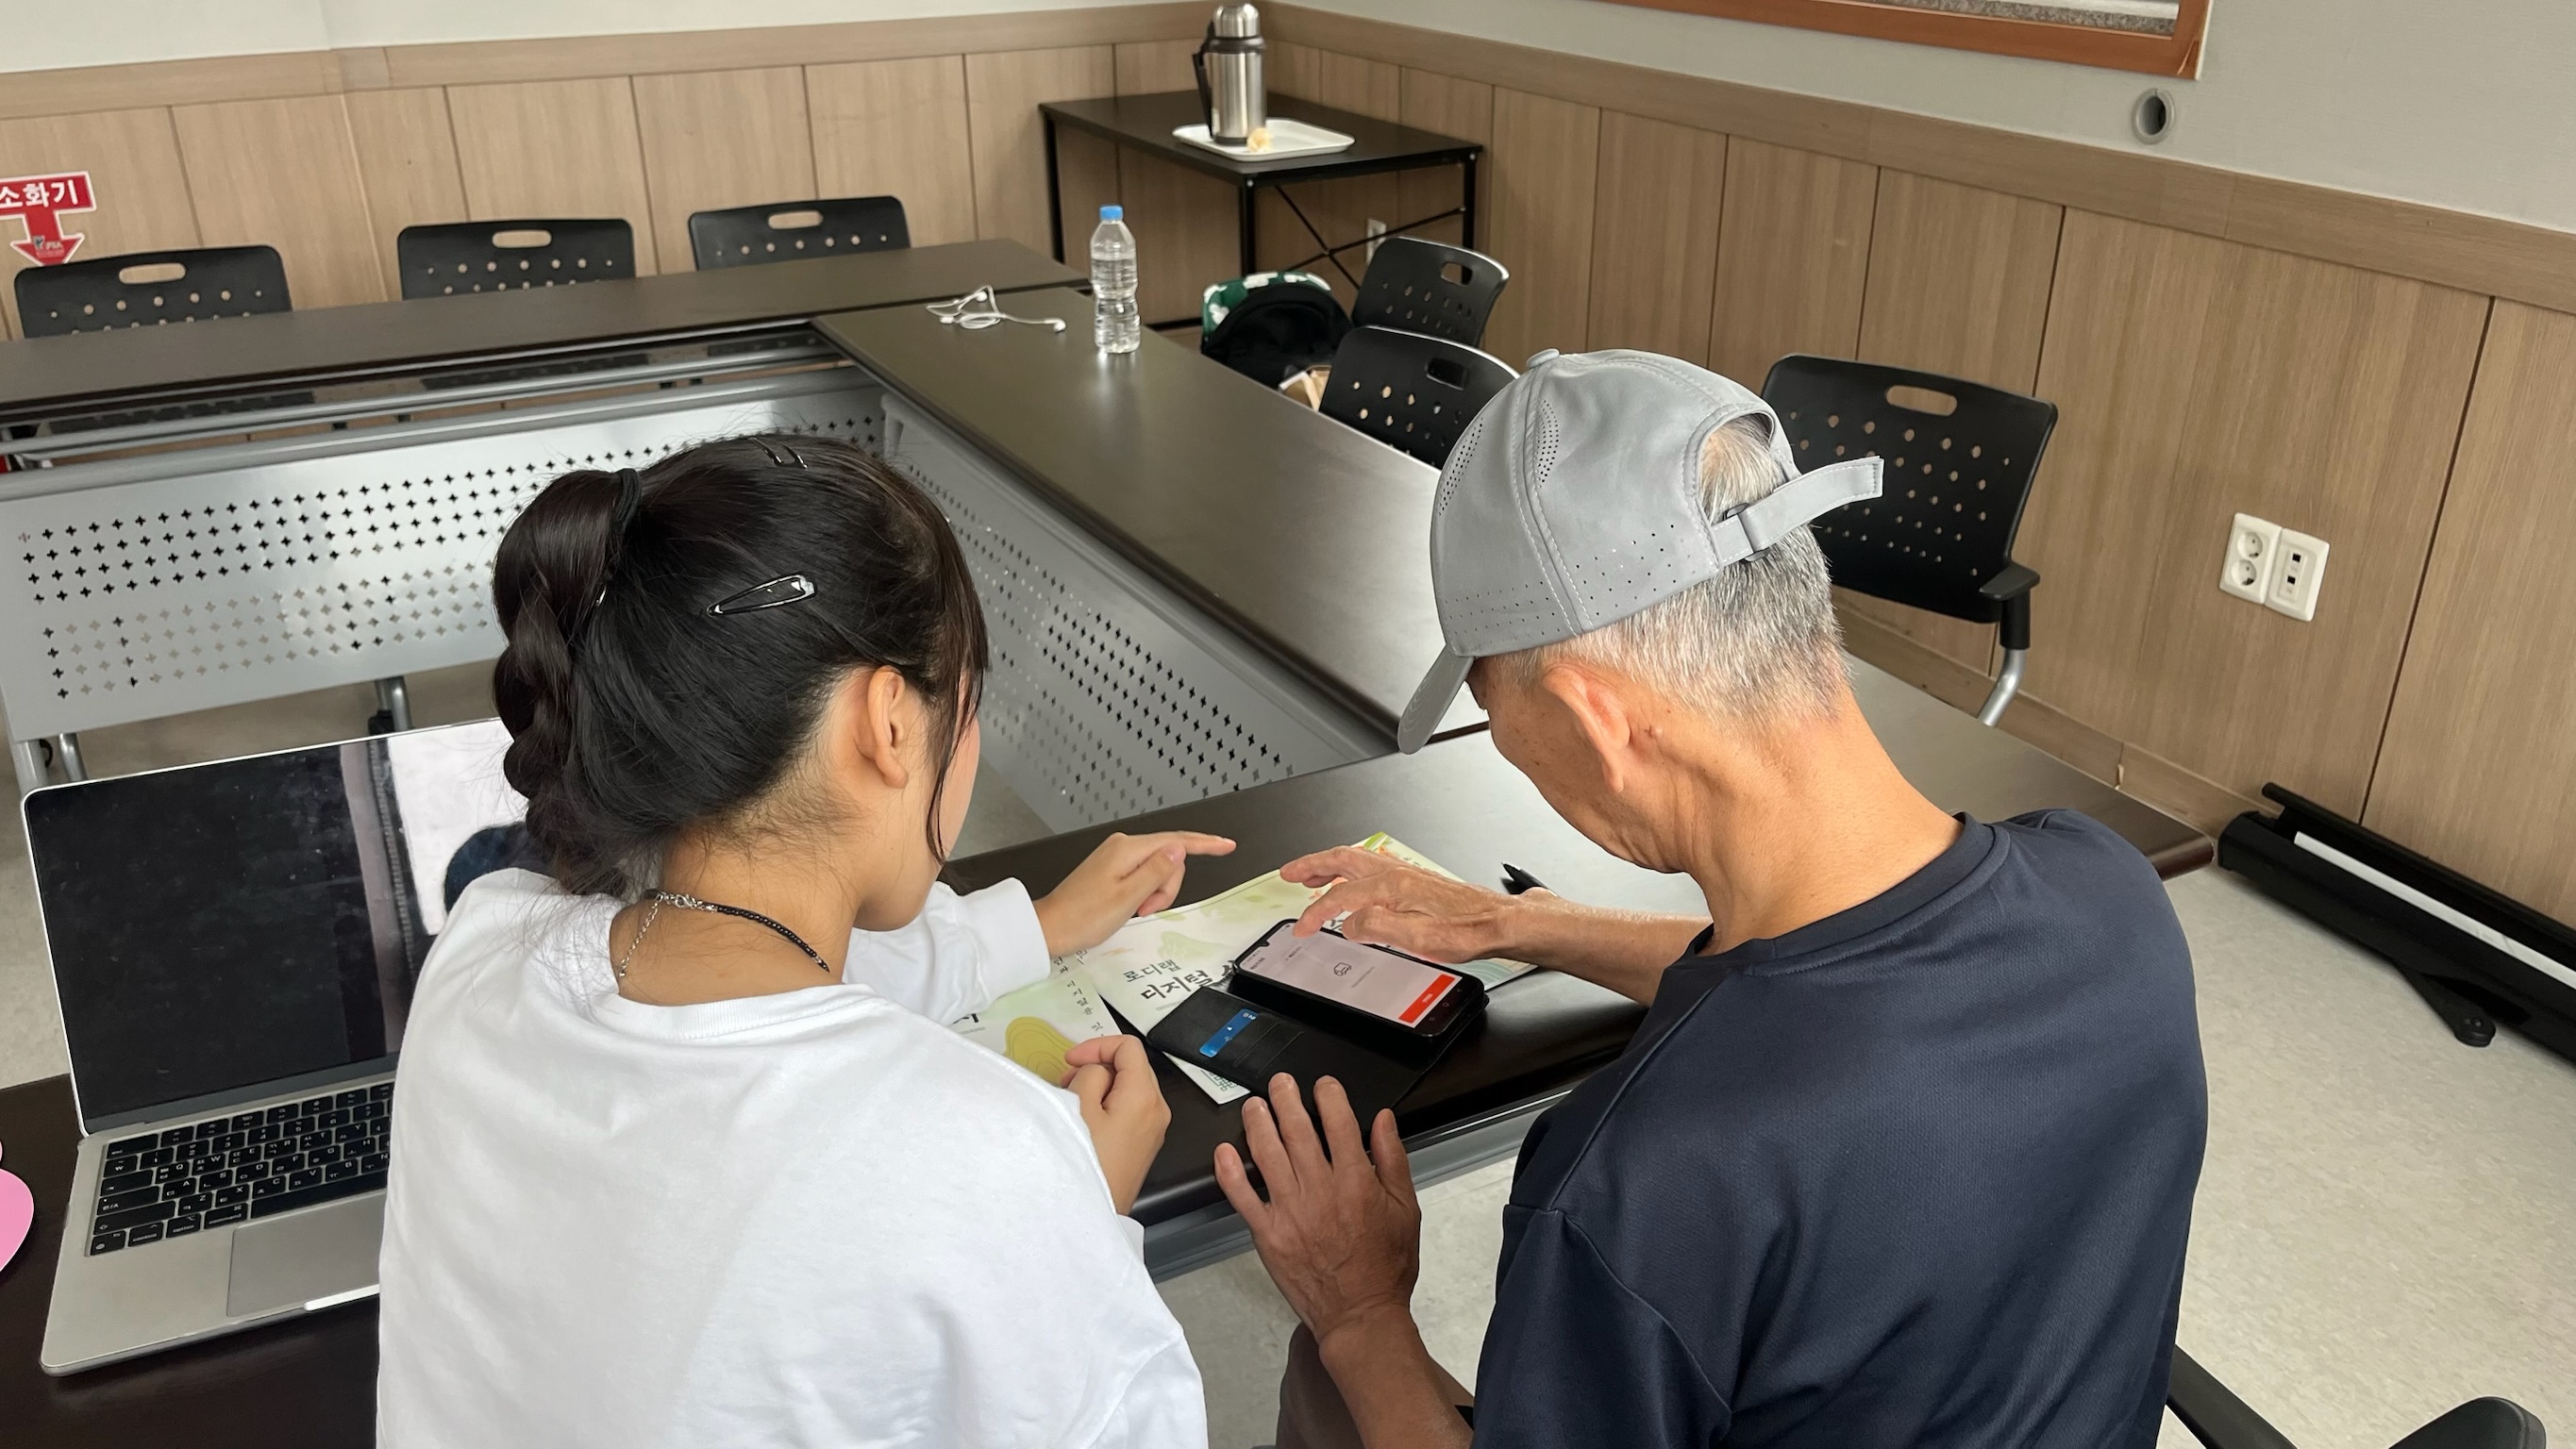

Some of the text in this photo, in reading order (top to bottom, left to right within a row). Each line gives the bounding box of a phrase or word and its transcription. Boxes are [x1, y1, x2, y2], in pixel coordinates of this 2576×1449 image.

[0, 179, 78, 208] 소화기
[1123, 958, 1181, 983] 로디랩
[1141, 970, 1213, 999] 디지털
